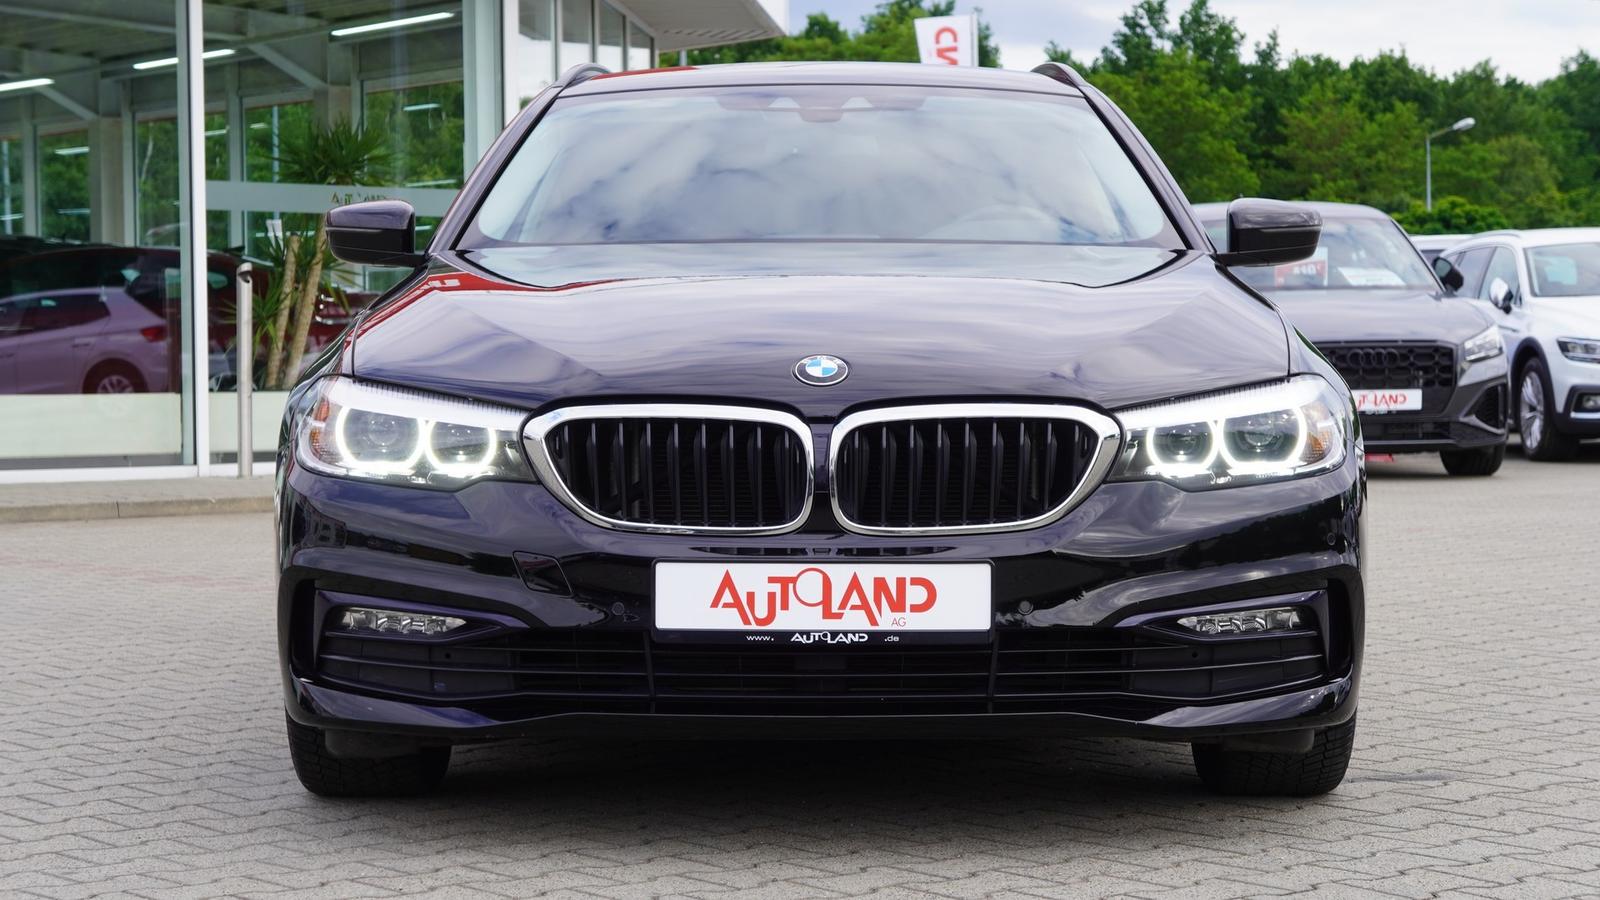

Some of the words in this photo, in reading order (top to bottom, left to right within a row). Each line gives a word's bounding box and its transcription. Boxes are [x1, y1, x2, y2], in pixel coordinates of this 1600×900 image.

[710, 567, 937, 627] AUTOLAND
[891, 617, 907, 627] AG
[790, 631, 868, 645] AUTOLAND
